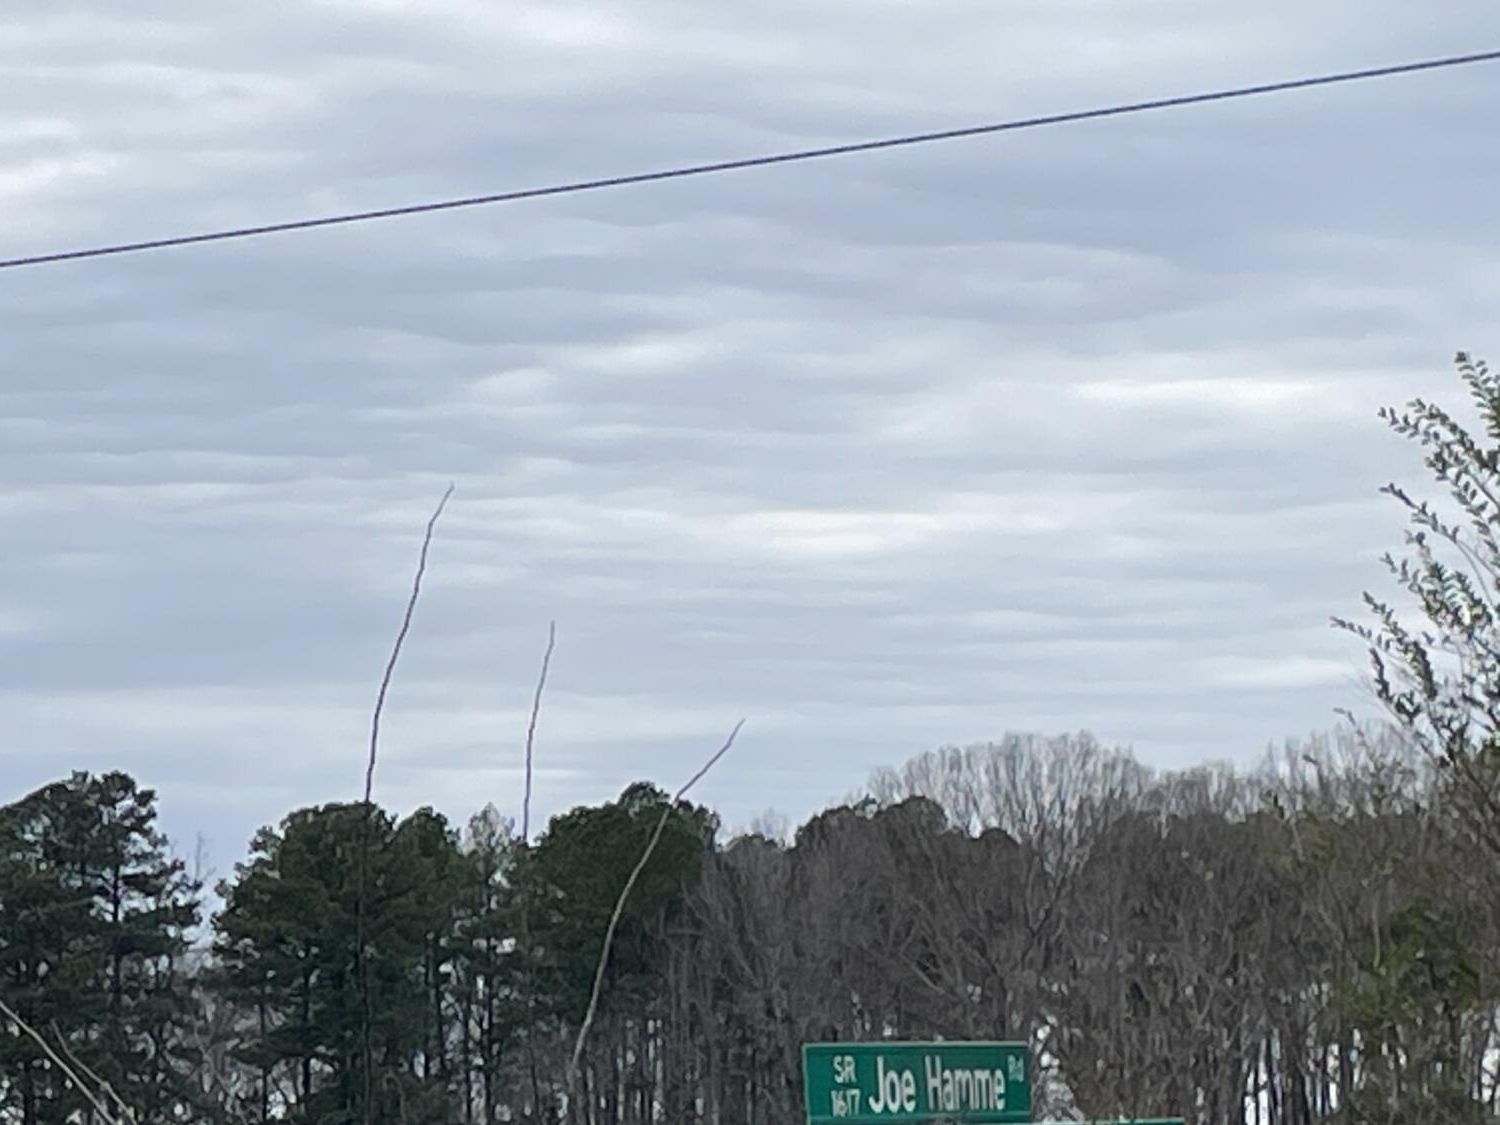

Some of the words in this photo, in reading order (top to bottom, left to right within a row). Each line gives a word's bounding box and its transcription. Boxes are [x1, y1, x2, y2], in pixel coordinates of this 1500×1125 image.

[833, 1055, 856, 1083] SR
[867, 1055, 916, 1114] Joe
[924, 1055, 1006, 1112] Hamme
